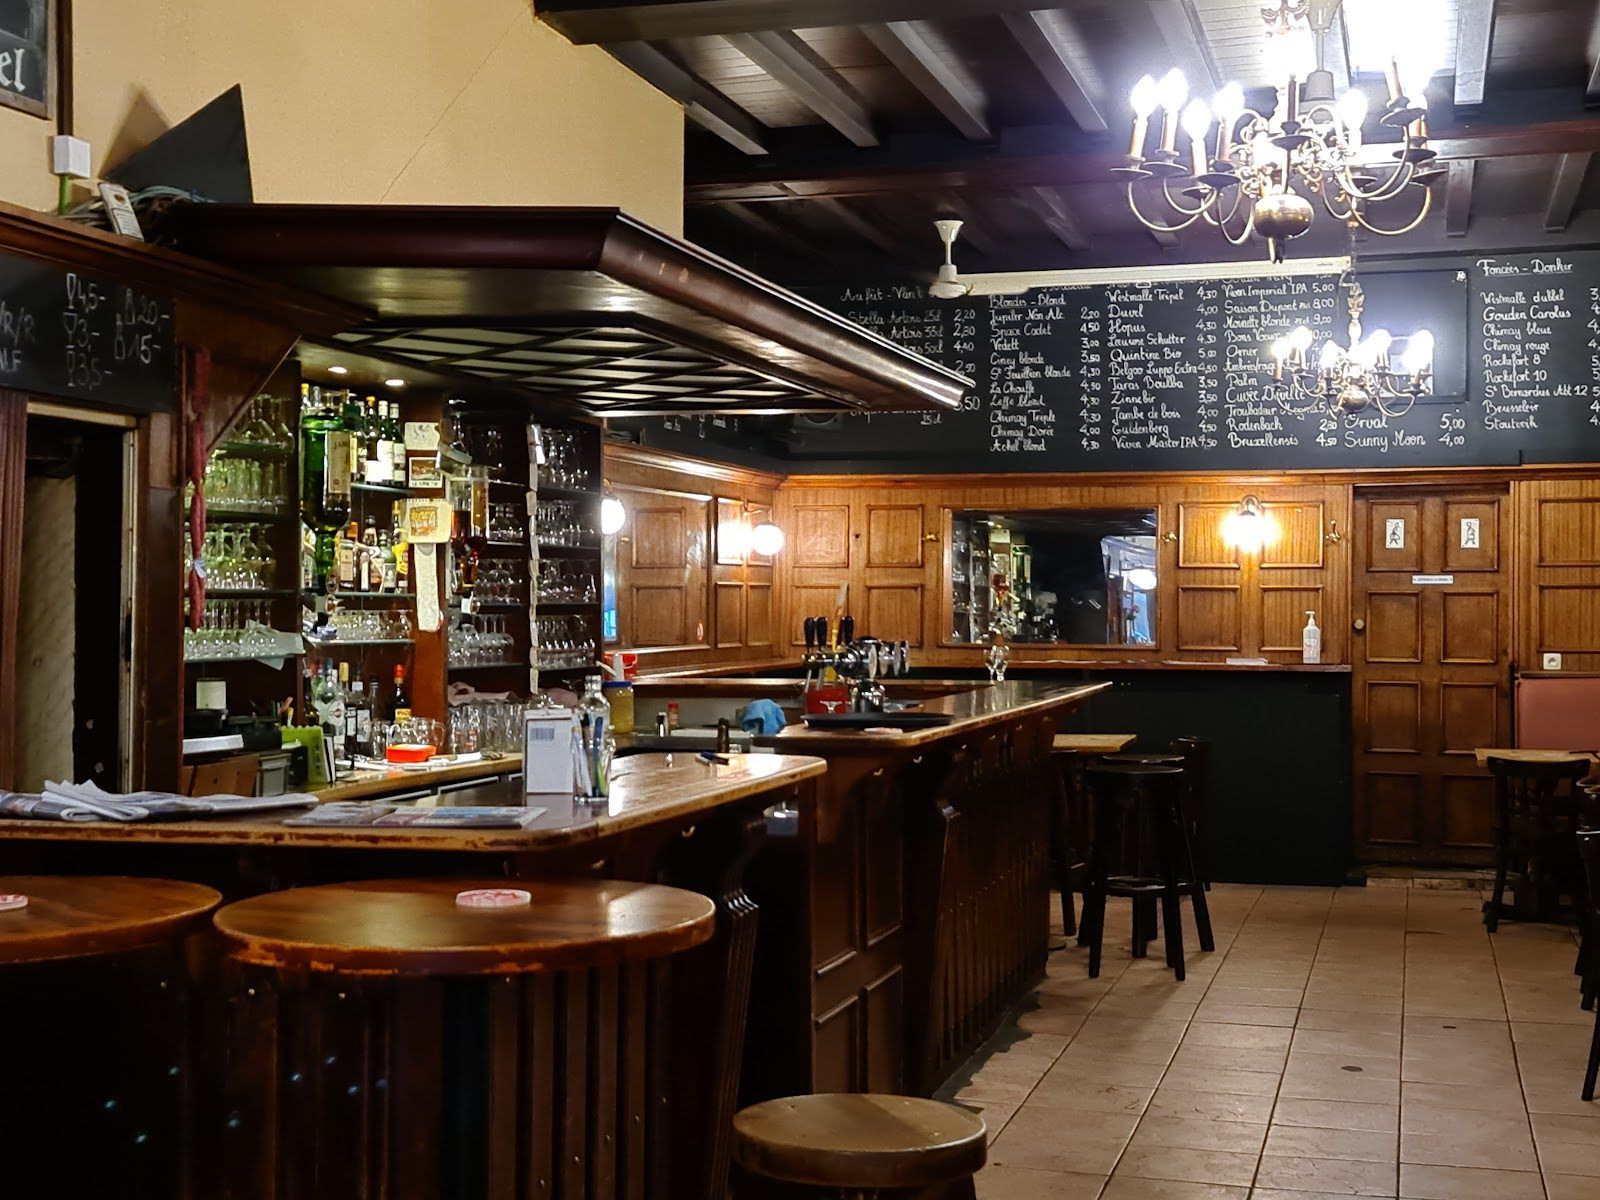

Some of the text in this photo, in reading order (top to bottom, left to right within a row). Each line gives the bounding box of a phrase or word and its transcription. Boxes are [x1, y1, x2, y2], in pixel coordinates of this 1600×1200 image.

[1530, 257, 1574, 273] Donker
[1105, 288, 1153, 302] Westmalle
[1154, 288, 1184, 304] Tripel
[1248, 284, 1287, 299] Imperial
[1291, 283, 1308, 294] IPA
[1312, 282, 1335, 293] 5,00
[1480, 291, 1527, 304] Westmalle
[1532, 288, 1565, 303] dubbel
[988, 293, 1066, 308] Blondes Blond
[1224, 300, 1259, 314] Saison
[1259, 299, 1297, 315] Dupont
[1312, 298, 1335, 309] 8,00
[848, 311, 884, 325] Stella
[989, 310, 1023, 325] Jupiler
[1025, 309, 1044, 320] Non
[1107, 303, 1218, 318] Duvel 4,00
[1483, 306, 1528, 321] Gouden
[1530, 305, 1572, 319] Carolus
[1108, 318, 1146, 337] Hopus
[1223, 315, 1259, 329] Moinette
[1260, 314, 1291, 327] blonde
[890, 326, 922, 339] Artois
[990, 323, 1021, 339] Space
[1023, 322, 1052, 336] Cadet
[1146, 332, 1186, 345] Schutter
[1224, 330, 1251, 342] Bons
[1483, 323, 1521, 340] Chimay
[1526, 321, 1552, 336] bleue
[990, 338, 1020, 351] Vedett
[1226, 344, 1258, 358] Omer
[1483, 338, 1522, 355] Chimay
[1525, 342, 1550, 356] rouge
[990, 352, 1016, 369] Ciney
[1019, 351, 1045, 364] blonde
[1110, 347, 1160, 362] Quintine
[1162, 347, 1182, 360] Bio
[1482, 353, 1530, 371] Rochefort
[1532, 353, 1542, 365] 8
[1045, 365, 1071, 378] blonde
[1108, 361, 1144, 380] Belgoo
[1174, 361, 1198, 374] Extra
[1483, 368, 1531, 388] Rochefort
[1533, 369, 1548, 382] 10
[1108, 377, 1140, 391] Taras
[1143, 374, 1184, 389] Boulba
[1225, 373, 1258, 387] Palm
[989, 381, 1002, 394] La
[1003, 380, 1035, 397] Chouffe
[1110, 389, 1156, 404] Zinnebir
[1225, 387, 1260, 403] Cuvée
[1501, 384, 1550, 398] Bernardus
[1553, 384, 1572, 396] Abt
[1573, 384, 1588, 396] 12
[989, 394, 1014, 409] Leffe
[1017, 394, 1045, 407] blond
[1224, 402, 1277, 417] Troubadour
[990, 409, 1027, 426] Chimay
[1110, 402, 1219, 426] Jambe de bois 4,00
[1344, 413, 1466, 431] Orval 5,00
[1484, 414, 1538, 430] Stouterik
[1226, 416, 1283, 432] Rodenbach
[990, 425, 1024, 441] Chimay
[1146, 434, 1180, 448] Master
[1180, 436, 1199, 448] IPA
[1344, 429, 1465, 452] Sunny Moon 4,00
